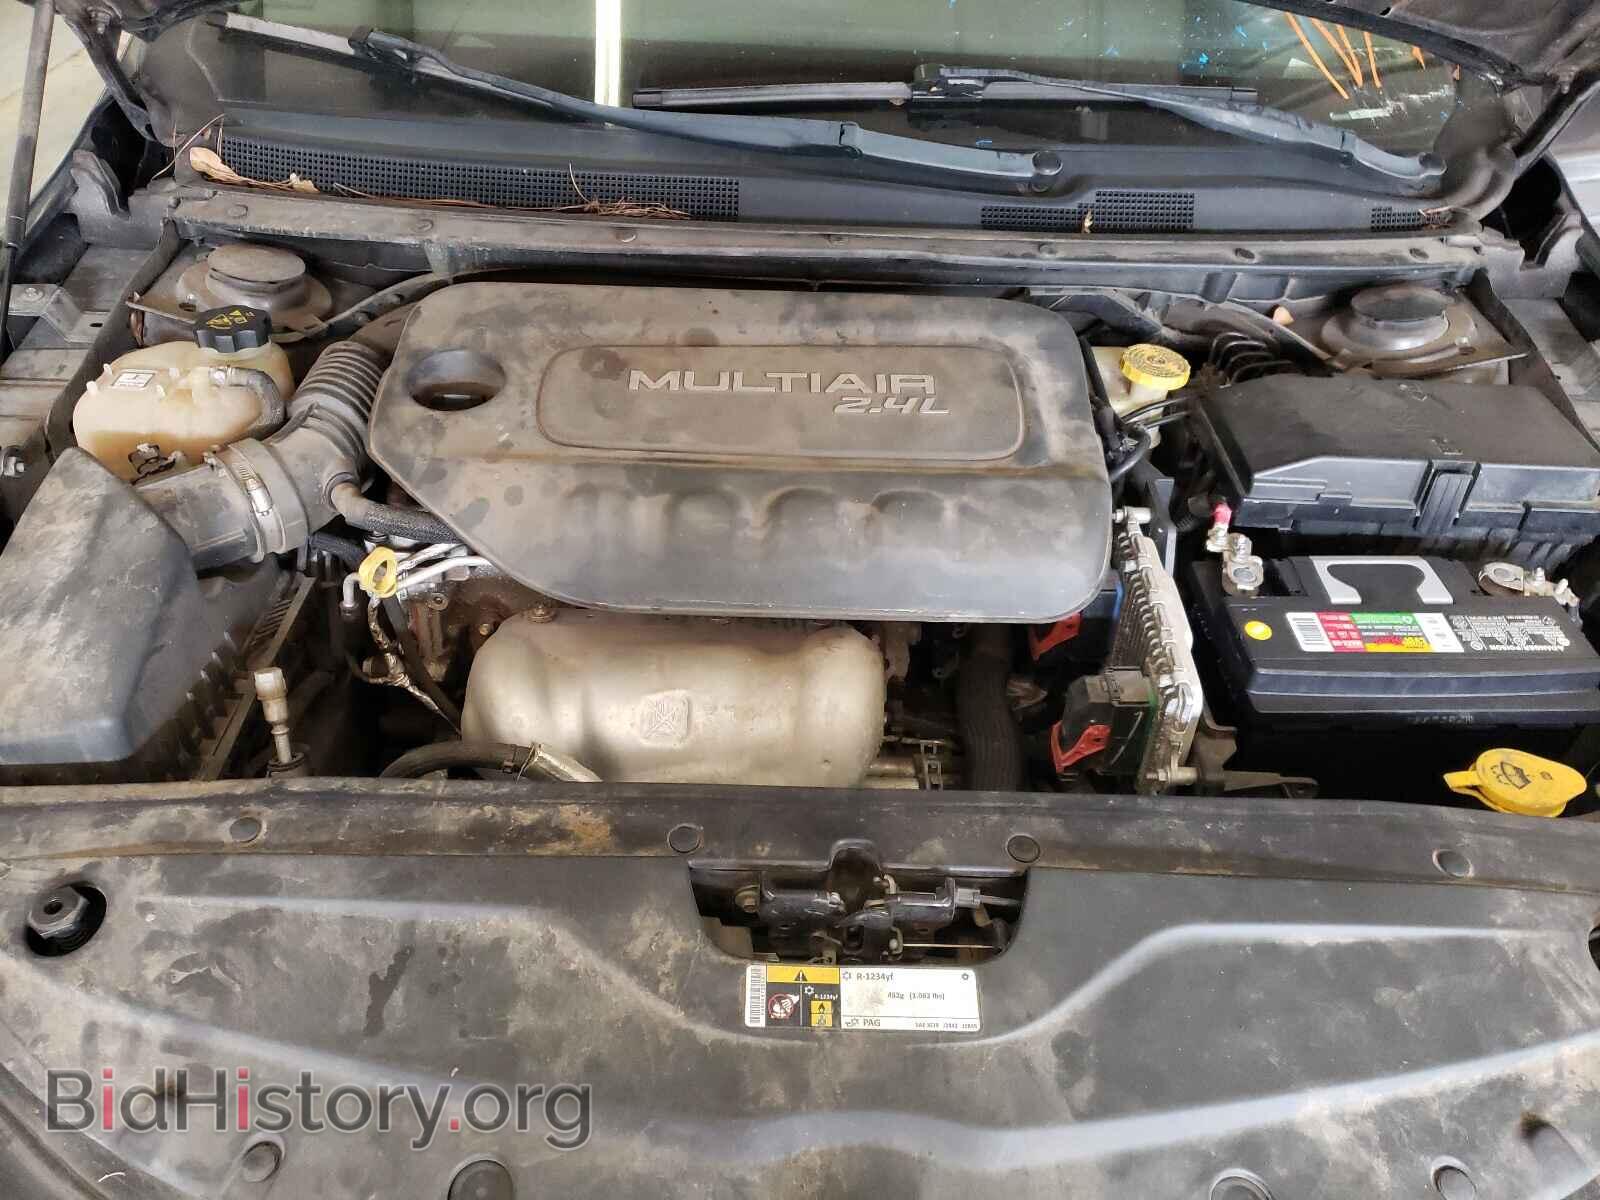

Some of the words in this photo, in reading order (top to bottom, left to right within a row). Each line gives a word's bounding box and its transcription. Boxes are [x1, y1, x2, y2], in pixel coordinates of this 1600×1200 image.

[629, 369, 936, 394] MULTIAIR
[833, 396, 950, 415] 2.4L
[857, 972, 894, 982] R-1234yf
[863, 1018, 881, 1027] PAG
